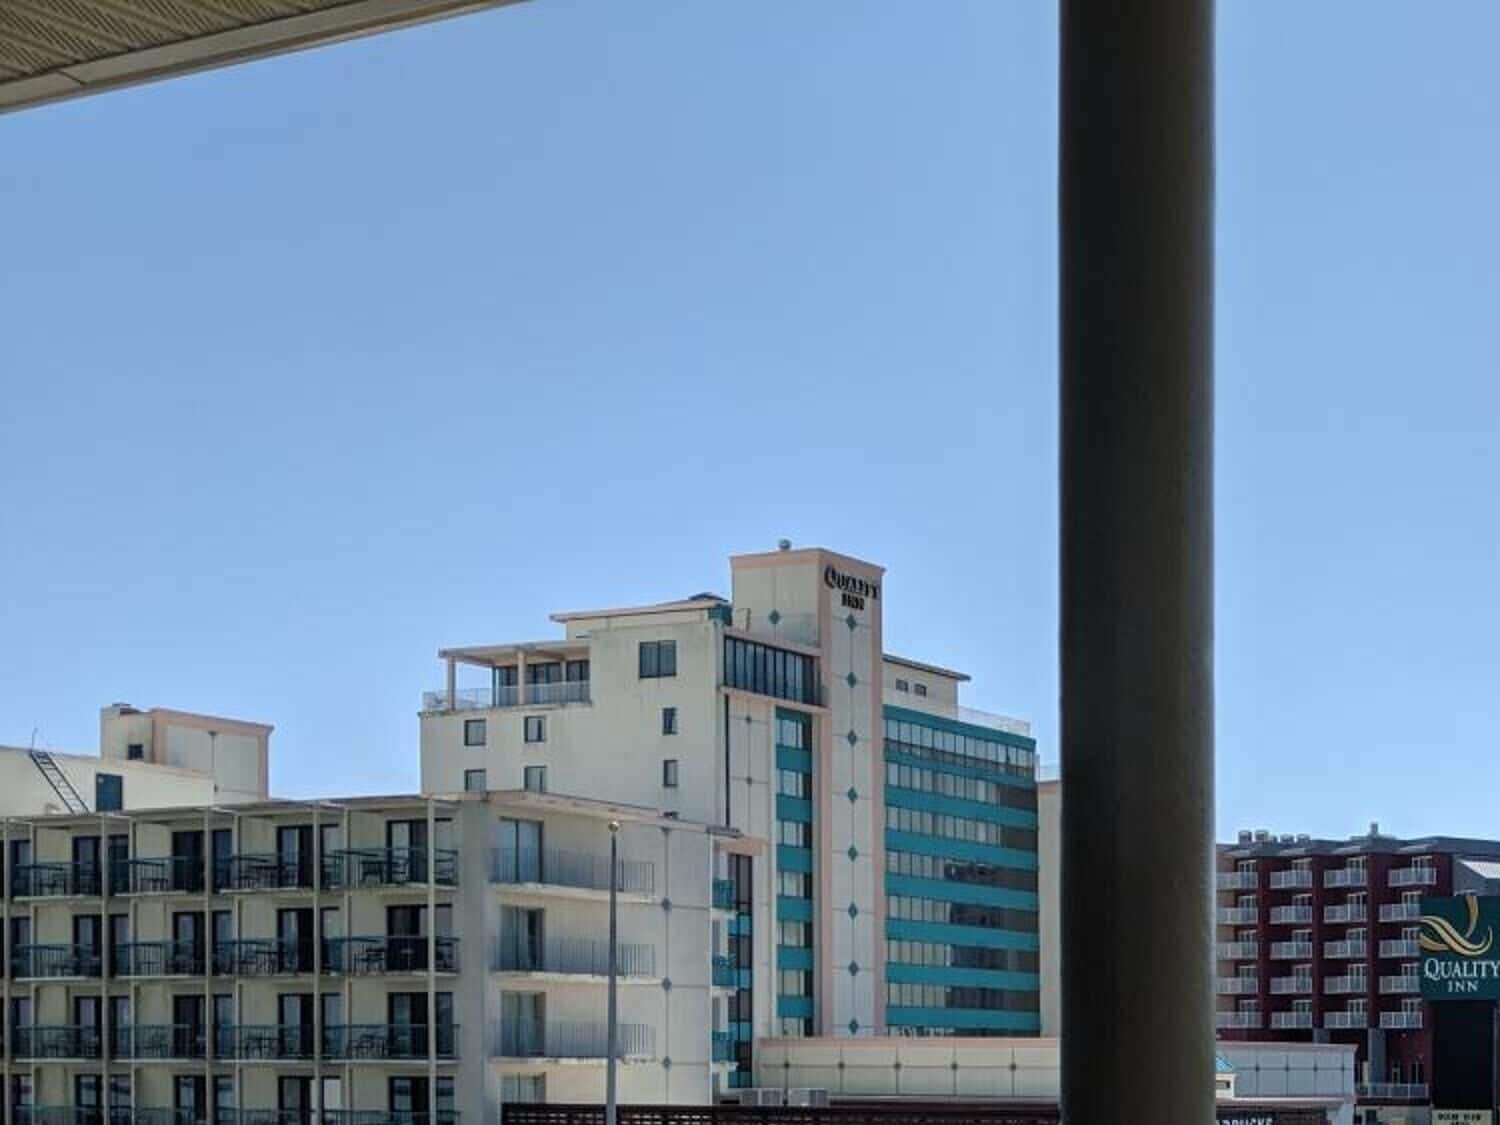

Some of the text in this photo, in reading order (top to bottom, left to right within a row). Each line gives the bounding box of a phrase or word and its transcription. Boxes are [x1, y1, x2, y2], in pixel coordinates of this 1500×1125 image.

[823, 564, 878, 599] QUALITY
[1424, 957, 1500, 981] QUALITY
[1448, 980, 1479, 993] INN
